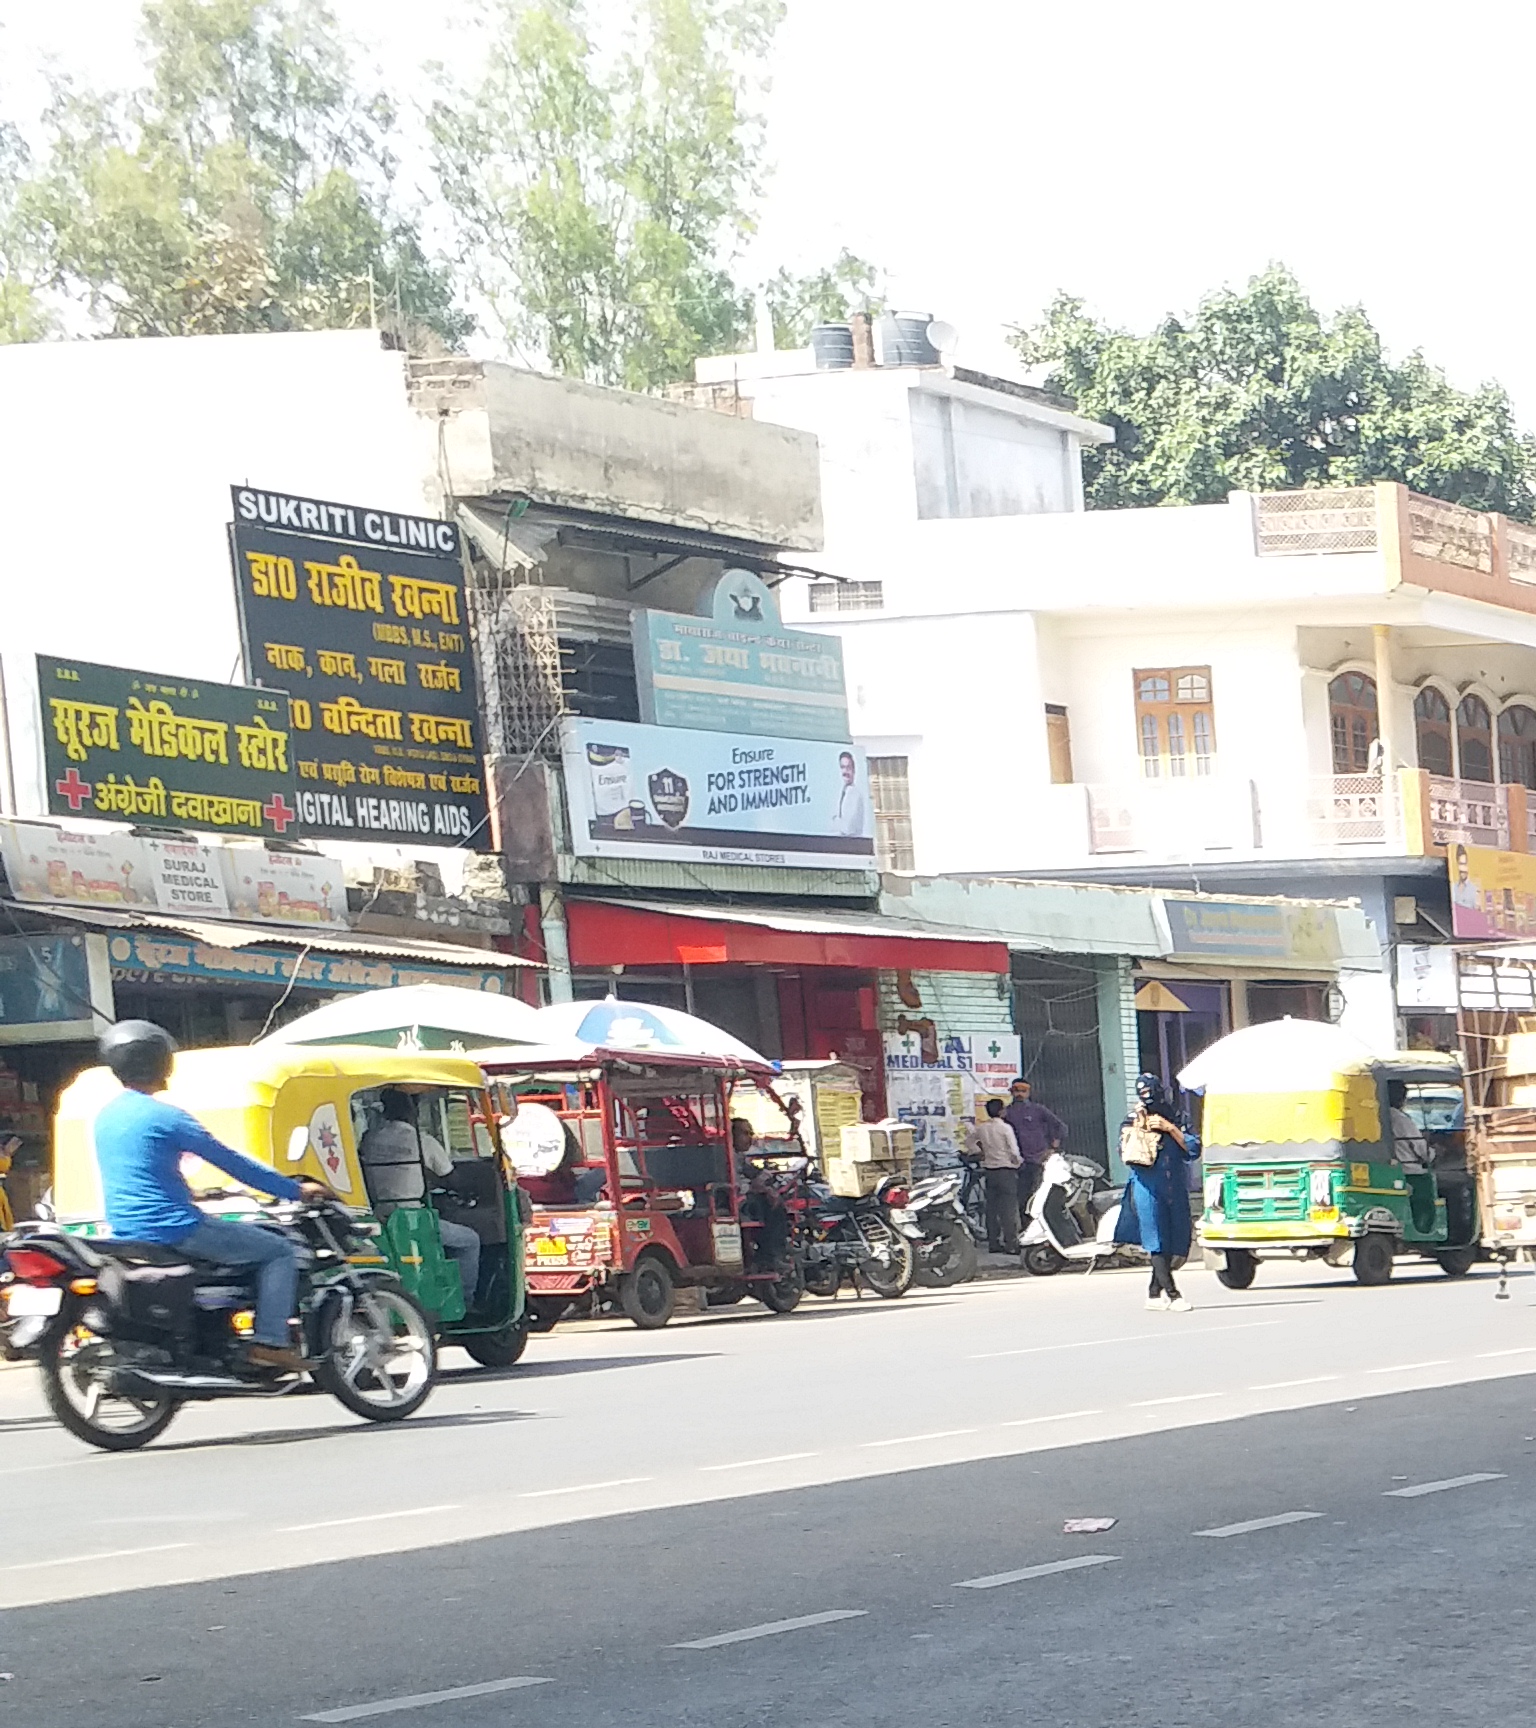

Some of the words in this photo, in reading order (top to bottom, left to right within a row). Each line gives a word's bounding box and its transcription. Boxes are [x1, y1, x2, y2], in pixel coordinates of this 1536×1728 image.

[238, 490, 357, 536] SUKRITI
[364, 512, 456, 552] CLINIC
[304, 555, 384, 614] राजीव
[388, 575, 460, 624] खन्ना
[264, 642, 313, 679] नाक,
[317, 649, 364, 685] कान,
[367, 657, 407, 686] गला
[417, 659, 462, 693] सर्जन
[49, 697, 120, 762] सूरज
[126, 696, 229, 765] मेडिकल
[234, 715, 288, 773] स्टोर
[319, 696, 403, 741] वन्दिता
[408, 713, 474, 748] खन्ना
[732, 747, 774, 765] Ensure
[707, 772, 737, 793] FOR
[737, 763, 807, 790] STRENGTH
[94, 773, 167, 817] अंग्रेजी
[170, 791, 262, 828] दवाखाना
[295, 791, 354, 828] IGITAL
[356, 797, 430, 833] HEARING
[433, 804, 471, 837] AIDS
[707, 796, 737, 815] AND
[740, 785, 811, 811] IMMUNITY.
[163, 858, 206, 873] SURAJ
[702, 851, 717, 860] RAJ
[719, 852, 754, 863] MEDICAL
[755, 854, 785, 864] STORES
[162, 874, 219, 890] MEDICAL
[171, 889, 213, 904] STORE
[536, 1255, 569, 1266] PRESS
